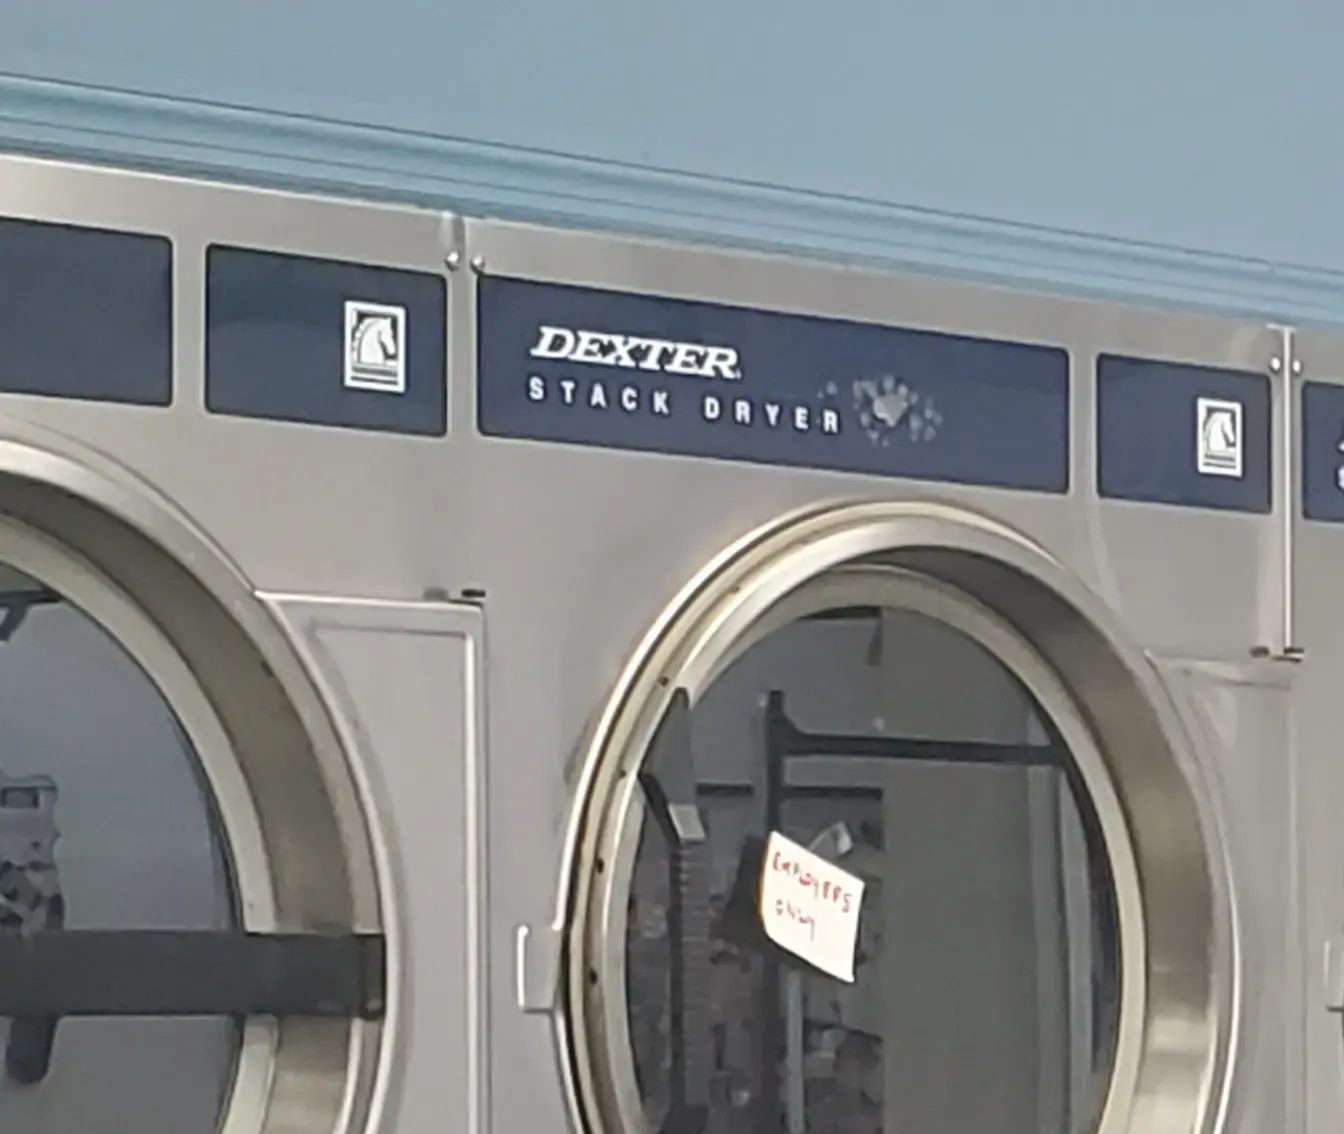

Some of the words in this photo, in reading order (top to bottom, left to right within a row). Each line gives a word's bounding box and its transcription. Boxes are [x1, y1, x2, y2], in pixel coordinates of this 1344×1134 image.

[530, 325, 742, 380] DEXTER
[528, 376, 671, 417] STACK
[704, 396, 842, 436] DRYER
